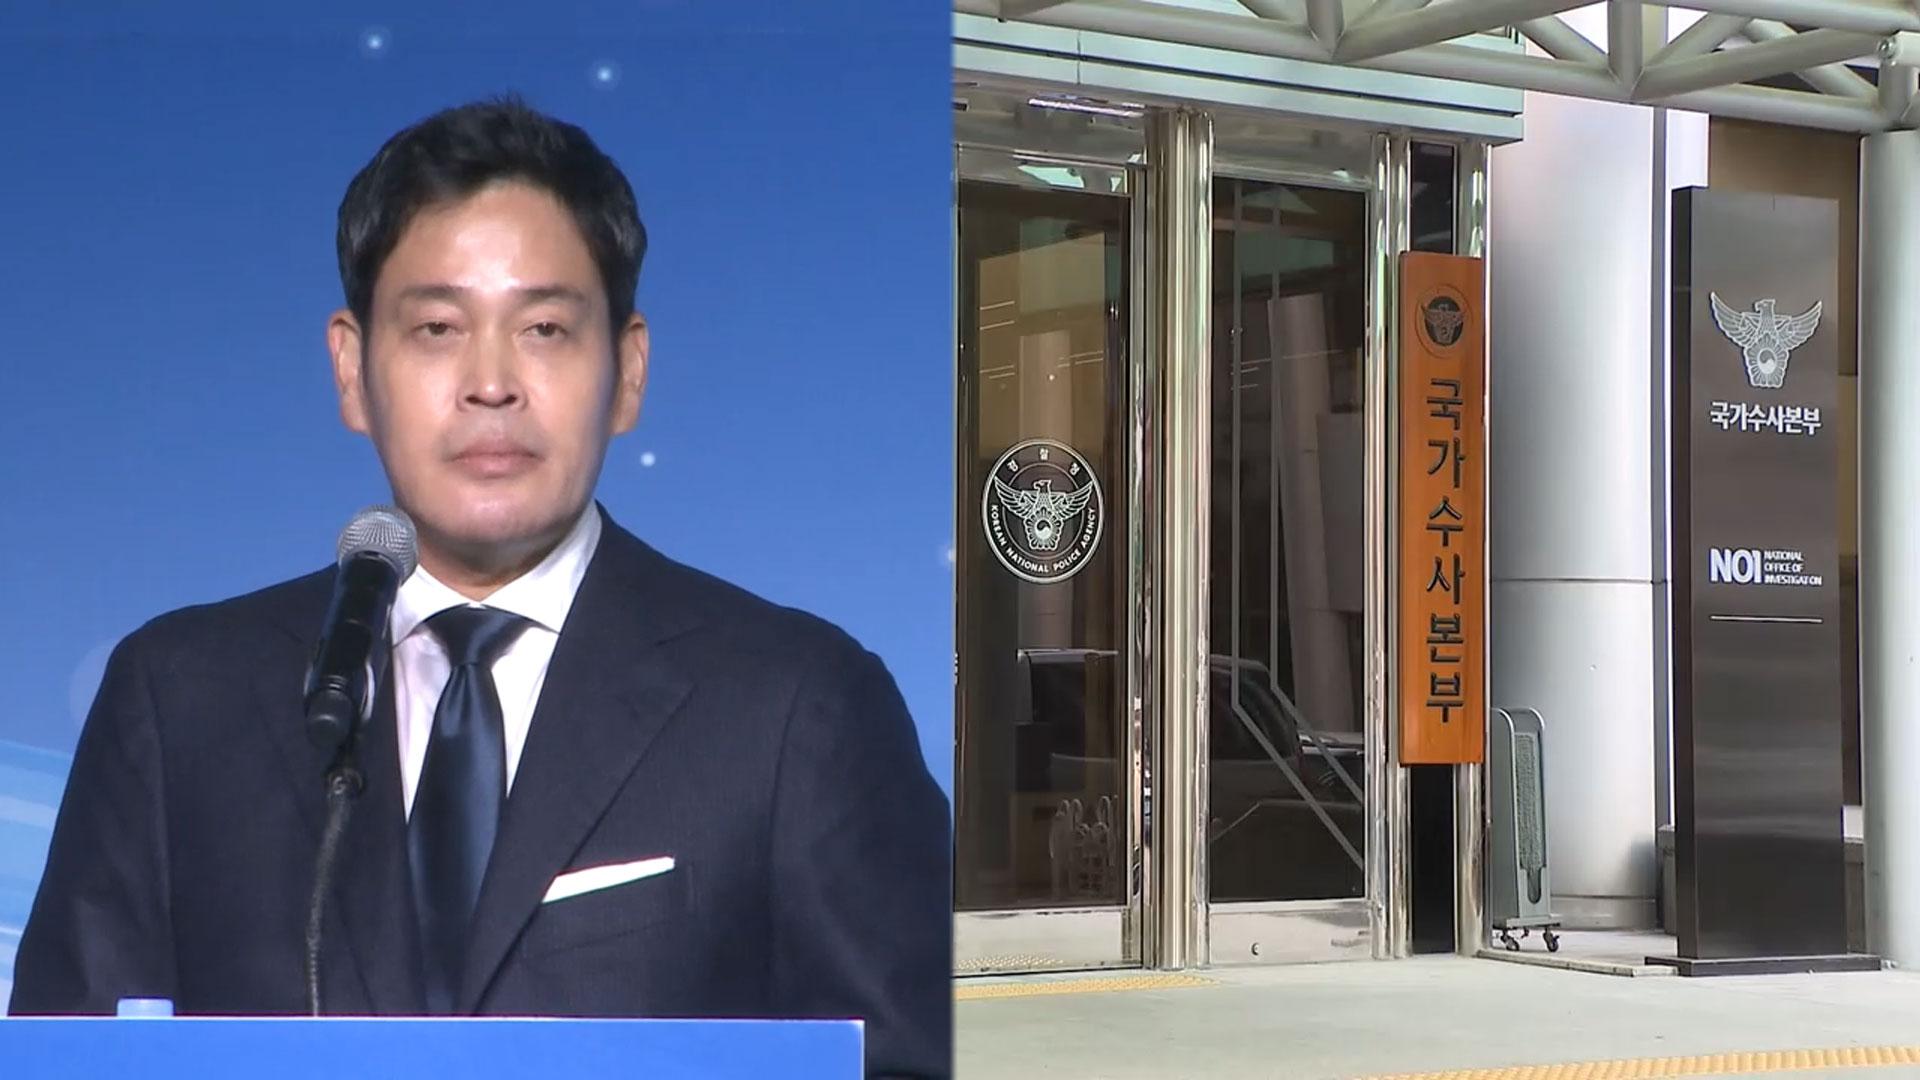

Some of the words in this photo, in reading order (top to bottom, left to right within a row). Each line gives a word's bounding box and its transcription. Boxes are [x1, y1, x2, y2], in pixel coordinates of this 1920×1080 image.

[1710, 401, 1822, 435] 국가수사본부
[991, 504, 1007, 546] KOREAN
[1006, 547, 1049, 573] NATIONAL
[1053, 548, 1081, 572] POLICE
[1081, 508, 1096, 548] AGENCY
[1426, 377, 1465, 723] 국가수사본부
[1764, 551, 1803, 562] NATIONAL
[1764, 562, 1792, 573] OFFICE
[1792, 563, 1804, 573] OF
[1764, 574, 1823, 586] INVESTIGATION
